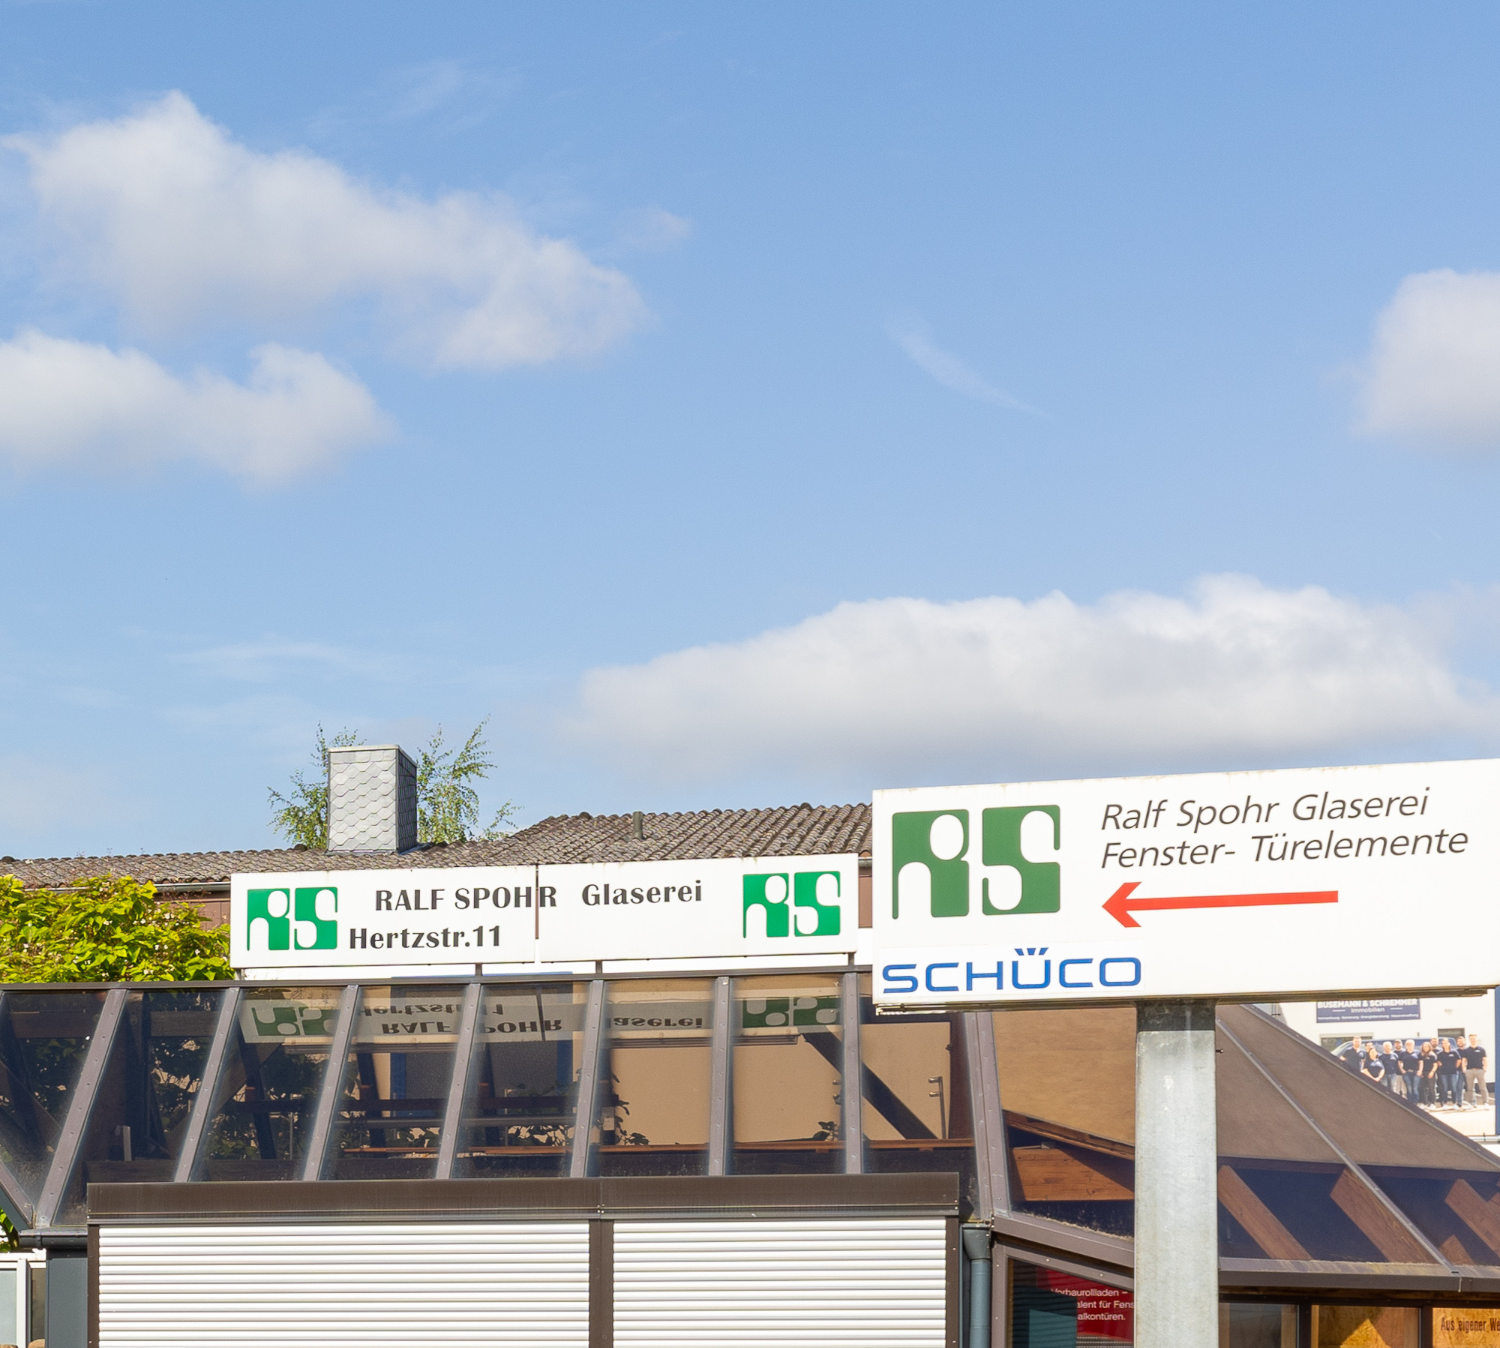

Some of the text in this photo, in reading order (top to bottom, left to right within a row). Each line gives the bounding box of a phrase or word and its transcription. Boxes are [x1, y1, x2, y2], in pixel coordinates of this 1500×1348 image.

[1101, 787, 1431, 834] Ralf Spohr Glaserei
[1101, 828, 1469, 869] Fenster- Türelemente
[375, 879, 702, 911] RALF SPOHR Glaserei
[349, 925, 500, 949] Hertzstr.11
[882, 947, 1142, 993] SCHÜCO
[1099, 1300, 1111, 1308] für
